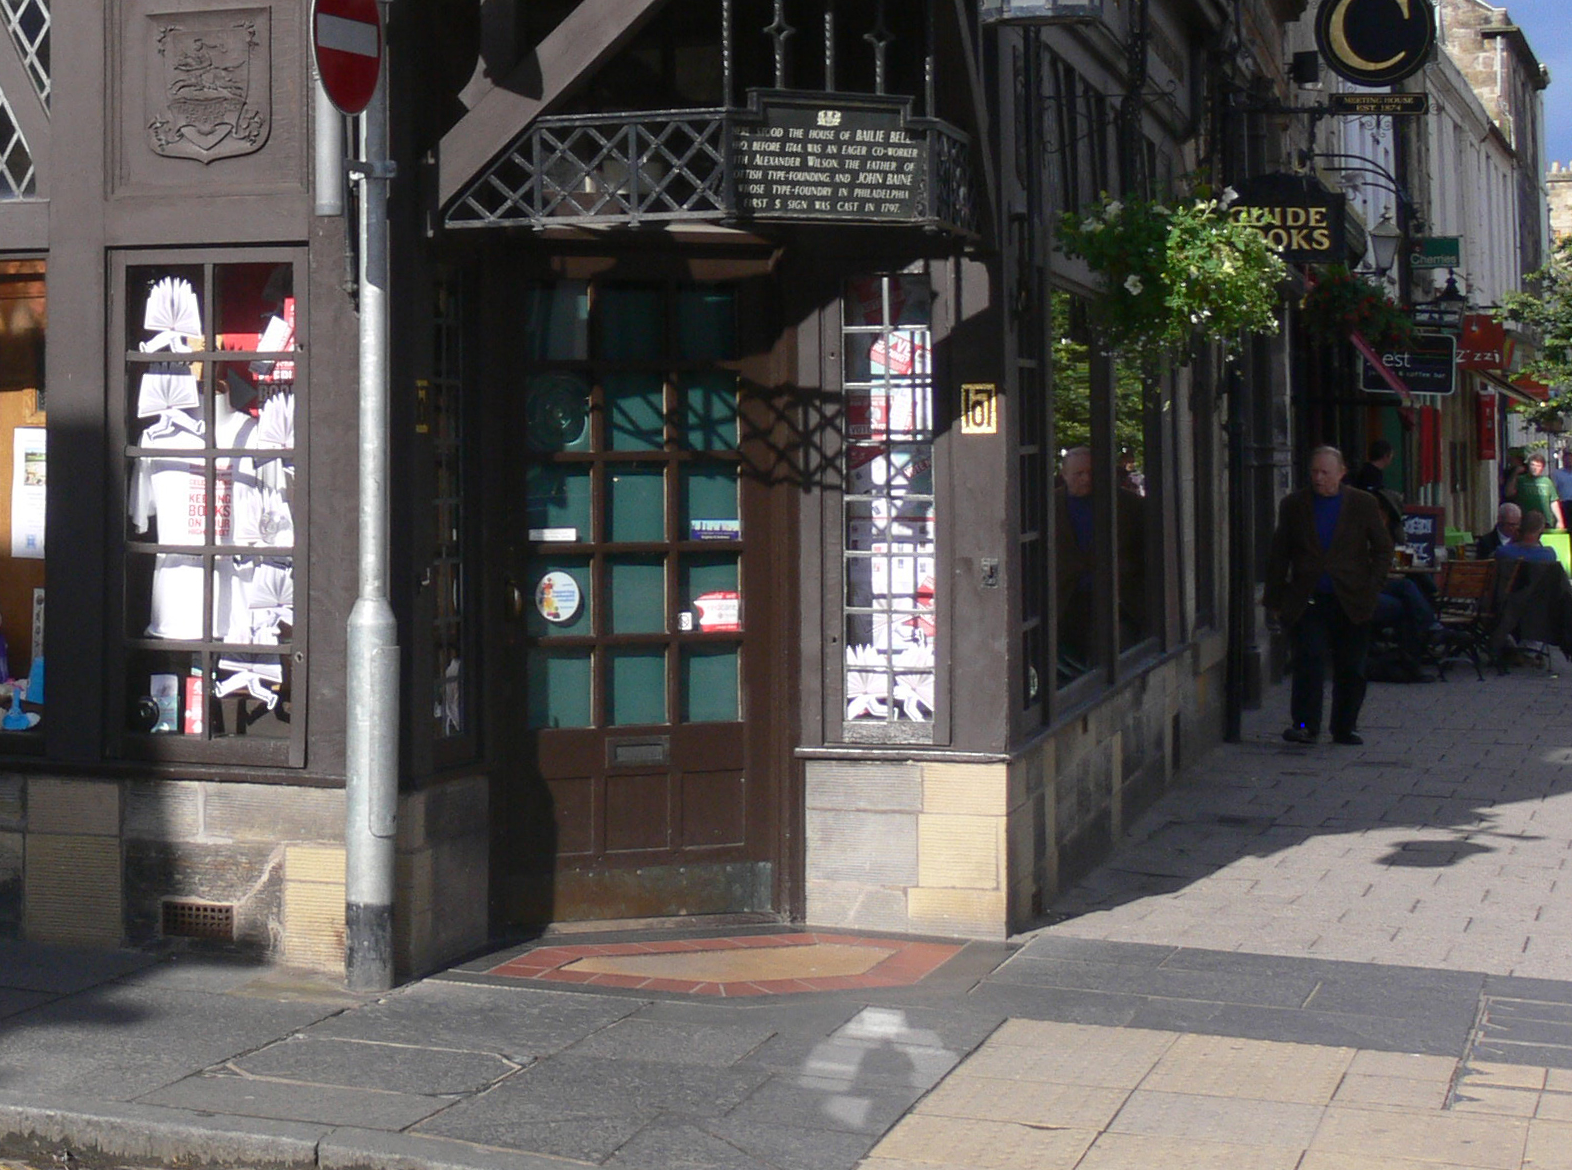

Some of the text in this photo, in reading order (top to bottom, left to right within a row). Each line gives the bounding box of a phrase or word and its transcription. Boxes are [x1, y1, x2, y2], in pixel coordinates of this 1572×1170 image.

[788, 128, 805, 139] THE
[808, 129, 836, 140] HOUSE
[839, 131, 852, 141] OF
[855, 129, 885, 143] BAILIE
[752, 141, 781, 152] BEFORE
[807, 143, 822, 154] WAS
[825, 144, 839, 154] AN
[841, 145, 868, 156] EAGER
[871, 147, 919, 158] CO-WORKER
[753, 153, 802, 167] ALEXANDER
[844, 159, 860, 170] THE
[866, 160, 897, 172] FATHER
[903, 162, 916, 172] OF
[834, 173, 851, 184] AND
[855, 172, 885, 184] JOHN
[886, 173, 914, 186] BAINE
[772, 184, 833, 197] TYPE-FOUNDRY
[838, 188, 849, 197] IN
[853, 188, 910, 200] PHILADELPHIA
[787, 199, 808, 210] SIGN
[814, 200, 831, 211] WAS
[836, 201, 860, 212] CAST
[864, 202, 876, 212] IN
